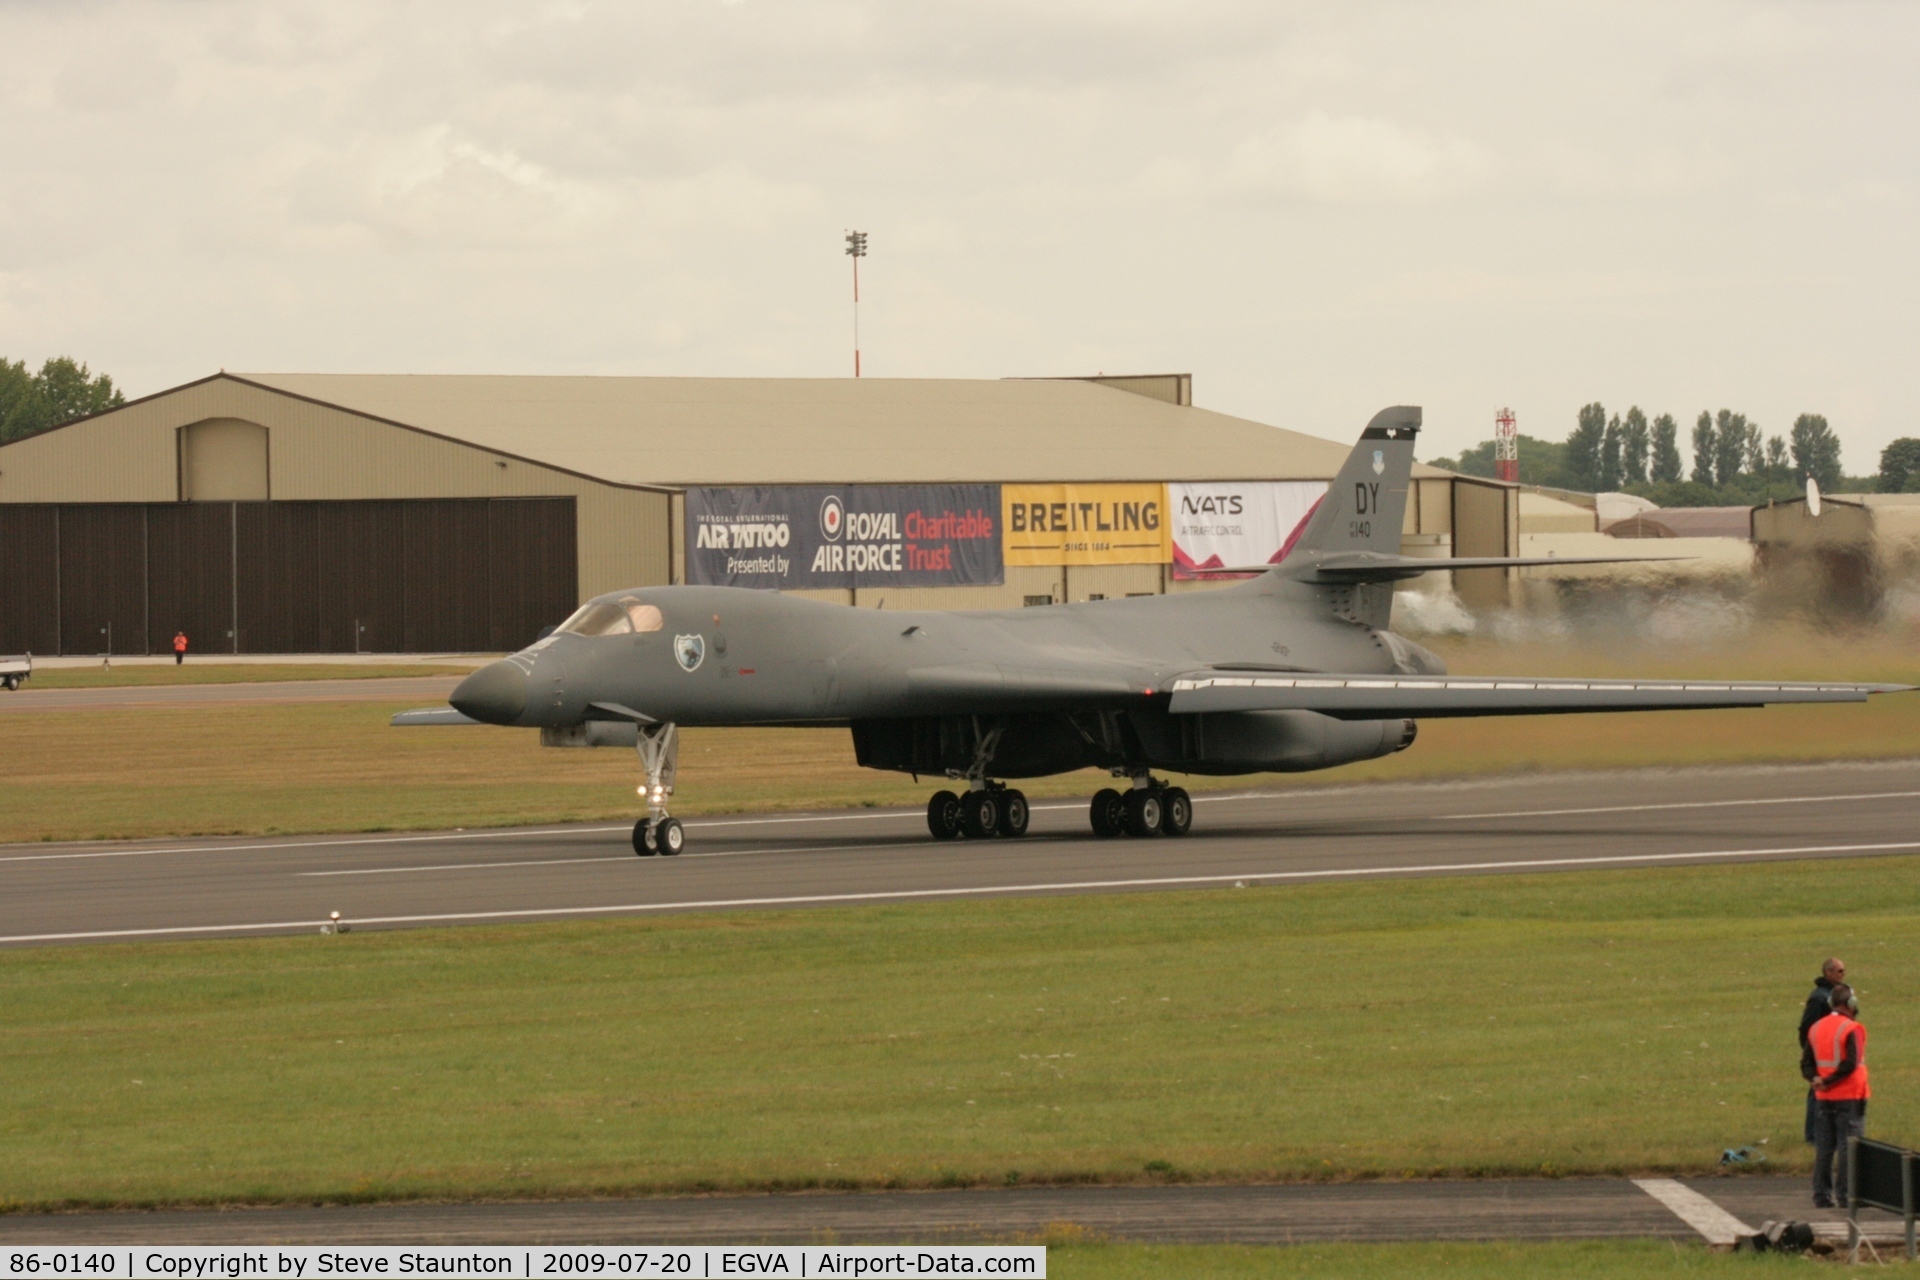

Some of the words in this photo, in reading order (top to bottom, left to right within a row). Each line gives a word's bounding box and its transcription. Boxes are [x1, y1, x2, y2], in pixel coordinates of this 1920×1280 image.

[1181, 495, 1243, 515] NATS
[1355, 482, 1379, 515] DY
[846, 512, 901, 541] ROYAL
[904, 509, 993, 540] Charitable
[1010, 501, 1160, 532] BREITLING
[1355, 521, 1371, 538] 140
[696, 524, 729, 549] AIR
[730, 522, 790, 549] TATTOO
[727, 554, 775, 574] Presented
[777, 554, 790, 577] by
[811, 545, 845, 572] AIR
[846, 544, 902, 572] FORCE
[905, 543, 952, 571] Trust
